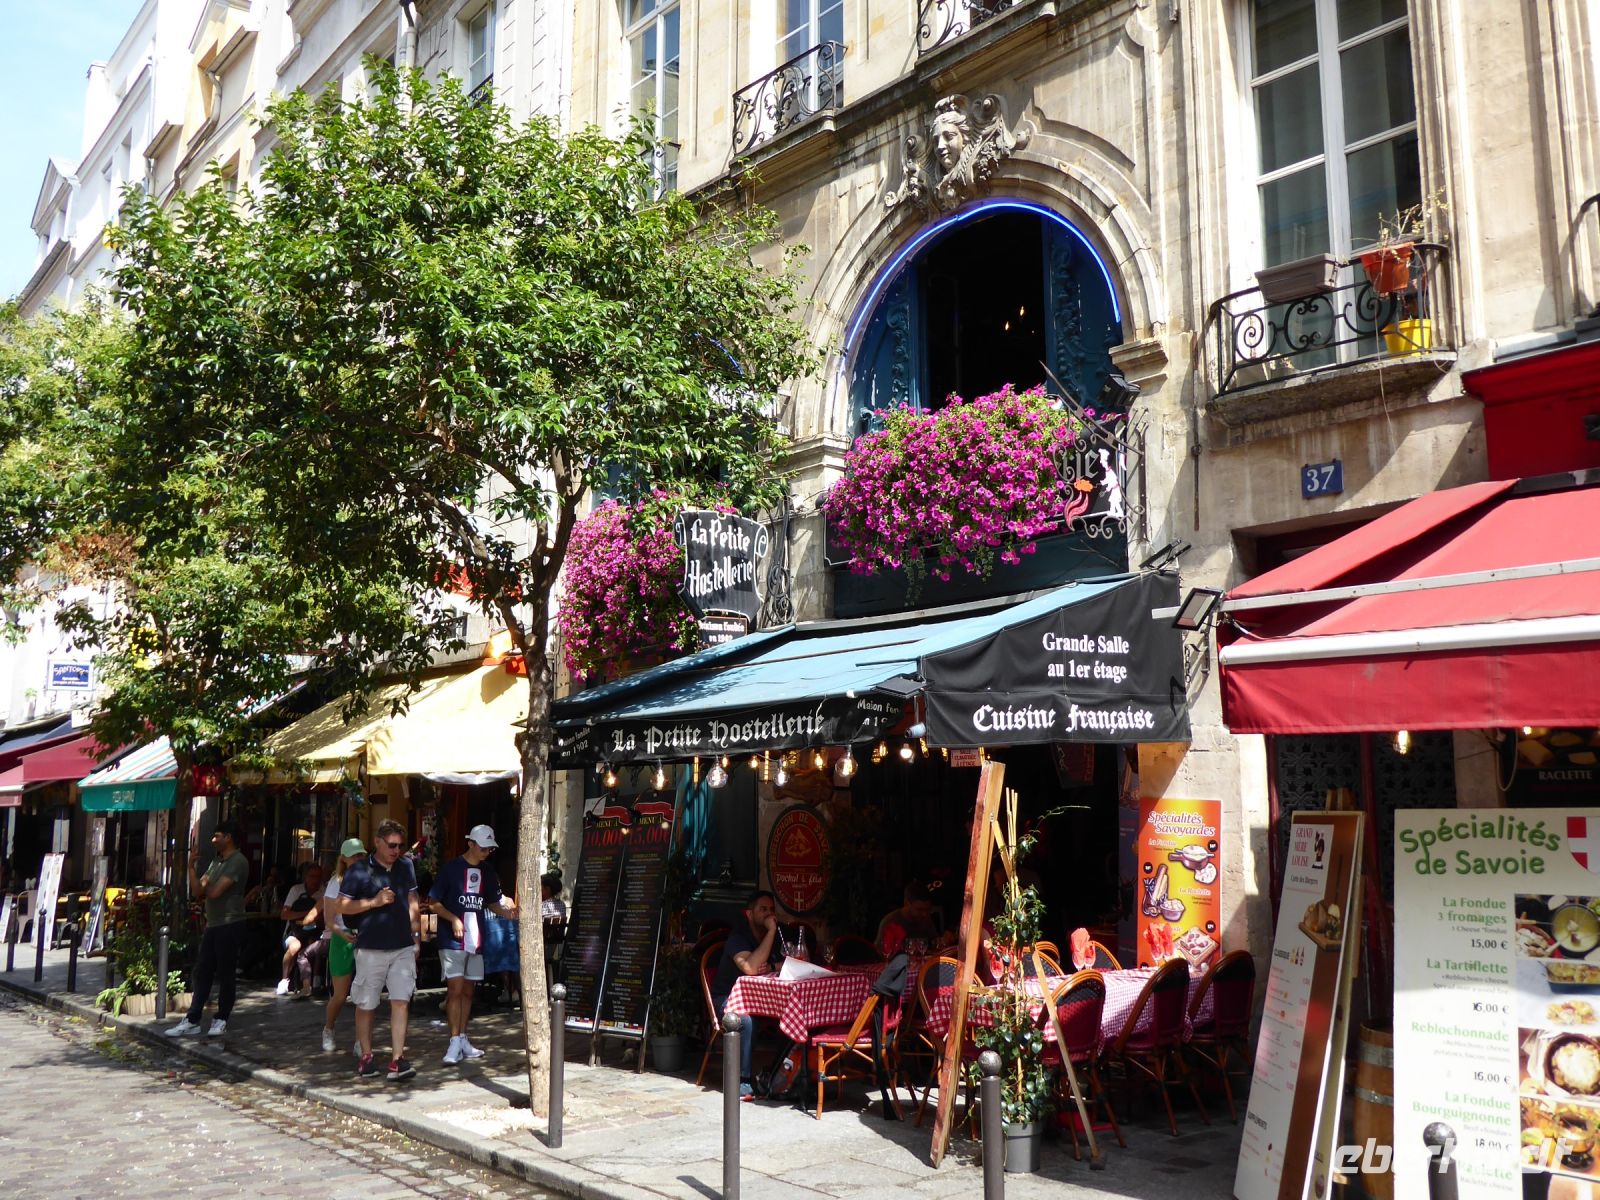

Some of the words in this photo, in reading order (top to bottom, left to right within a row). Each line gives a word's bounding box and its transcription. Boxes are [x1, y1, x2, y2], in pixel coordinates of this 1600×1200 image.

[1307, 465, 1334, 492] 37
[690, 519, 707, 545] La
[709, 519, 750, 552] Petite
[688, 555, 753, 598] Hostellerie
[1042, 632, 1095, 652] Grande
[1097, 634, 1130, 654] Salle
[1047, 662, 1064, 677] au
[1068, 660, 1091, 678] 1er
[1093, 660, 1127, 683] étage
[973, 704, 1057, 732] Cuisine
[612, 729, 637, 753] La
[644, 726, 702, 754] Petite
[708, 709, 826, 749] Hostellerie
[573, 739, 588, 754] 1902
[1538, 769, 1593, 780] RACLETTE
[1148, 811, 1203, 825] Spécialités
[1155, 823, 1215, 837] Savoyardes
[1296, 828, 1313, 839] GRAND
[1399, 814, 1561, 854] Spécialités
[1415, 849, 1447, 875] de
[1456, 849, 1545, 875] Savoie
[458, 895, 484, 906] QATAR
[1442, 896, 1457, 907] La
[1460, 897, 1507, 910] Fondue
[1438, 912, 1444, 921] 3
[1448, 911, 1507, 926] fromages
[1471, 939, 1497, 949] 15,00
[1501, 941, 1508, 950] €
[1427, 958, 1441, 969] La
[1445, 959, 1508, 974] Tartiflette
[1502, 1005, 1510, 1014] €
[1412, 1021, 1510, 1041] Reblochonnade
[1504, 1075, 1511, 1084] €
[1445, 1091, 1459, 1102] La
[1464, 1093, 1511, 1109] Fondue
[1412, 1101, 1511, 1126] Bourguignonne
